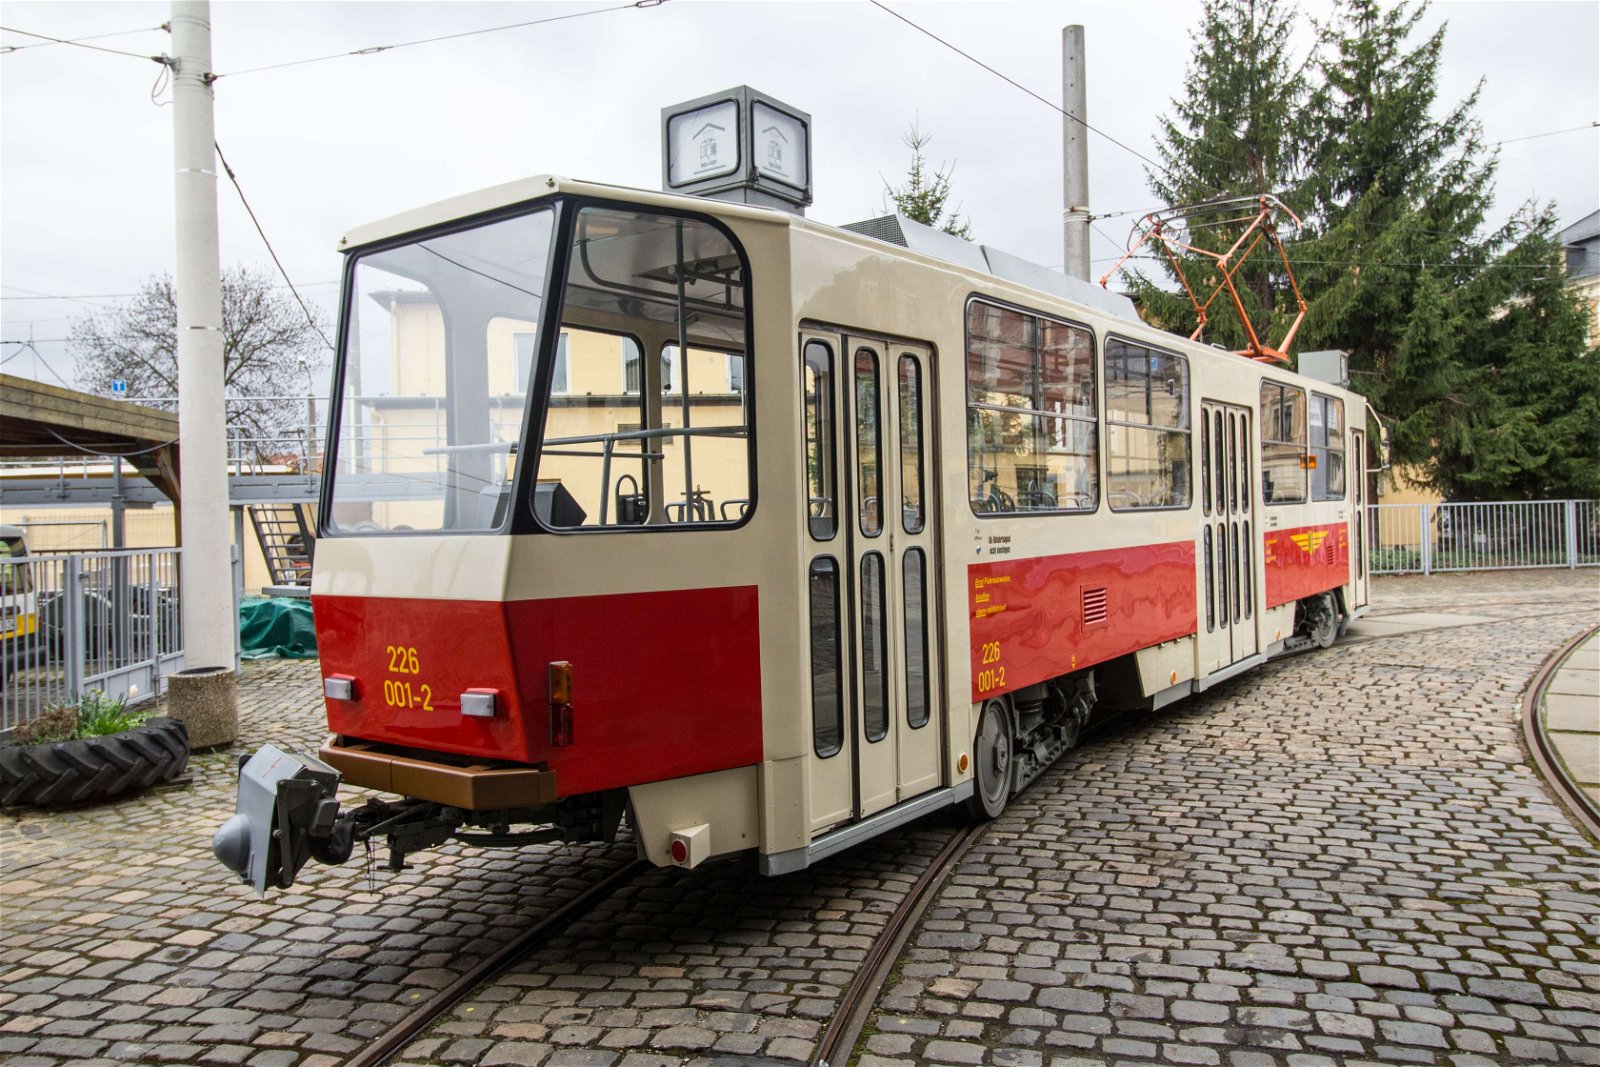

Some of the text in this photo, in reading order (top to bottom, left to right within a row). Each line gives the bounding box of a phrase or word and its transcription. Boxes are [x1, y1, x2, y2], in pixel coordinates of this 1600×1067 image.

[387, 645, 420, 675] 226
[982, 640, 1000, 665] 226
[978, 666, 1006, 693] 001-2
[384, 679, 434, 712] 001-2
